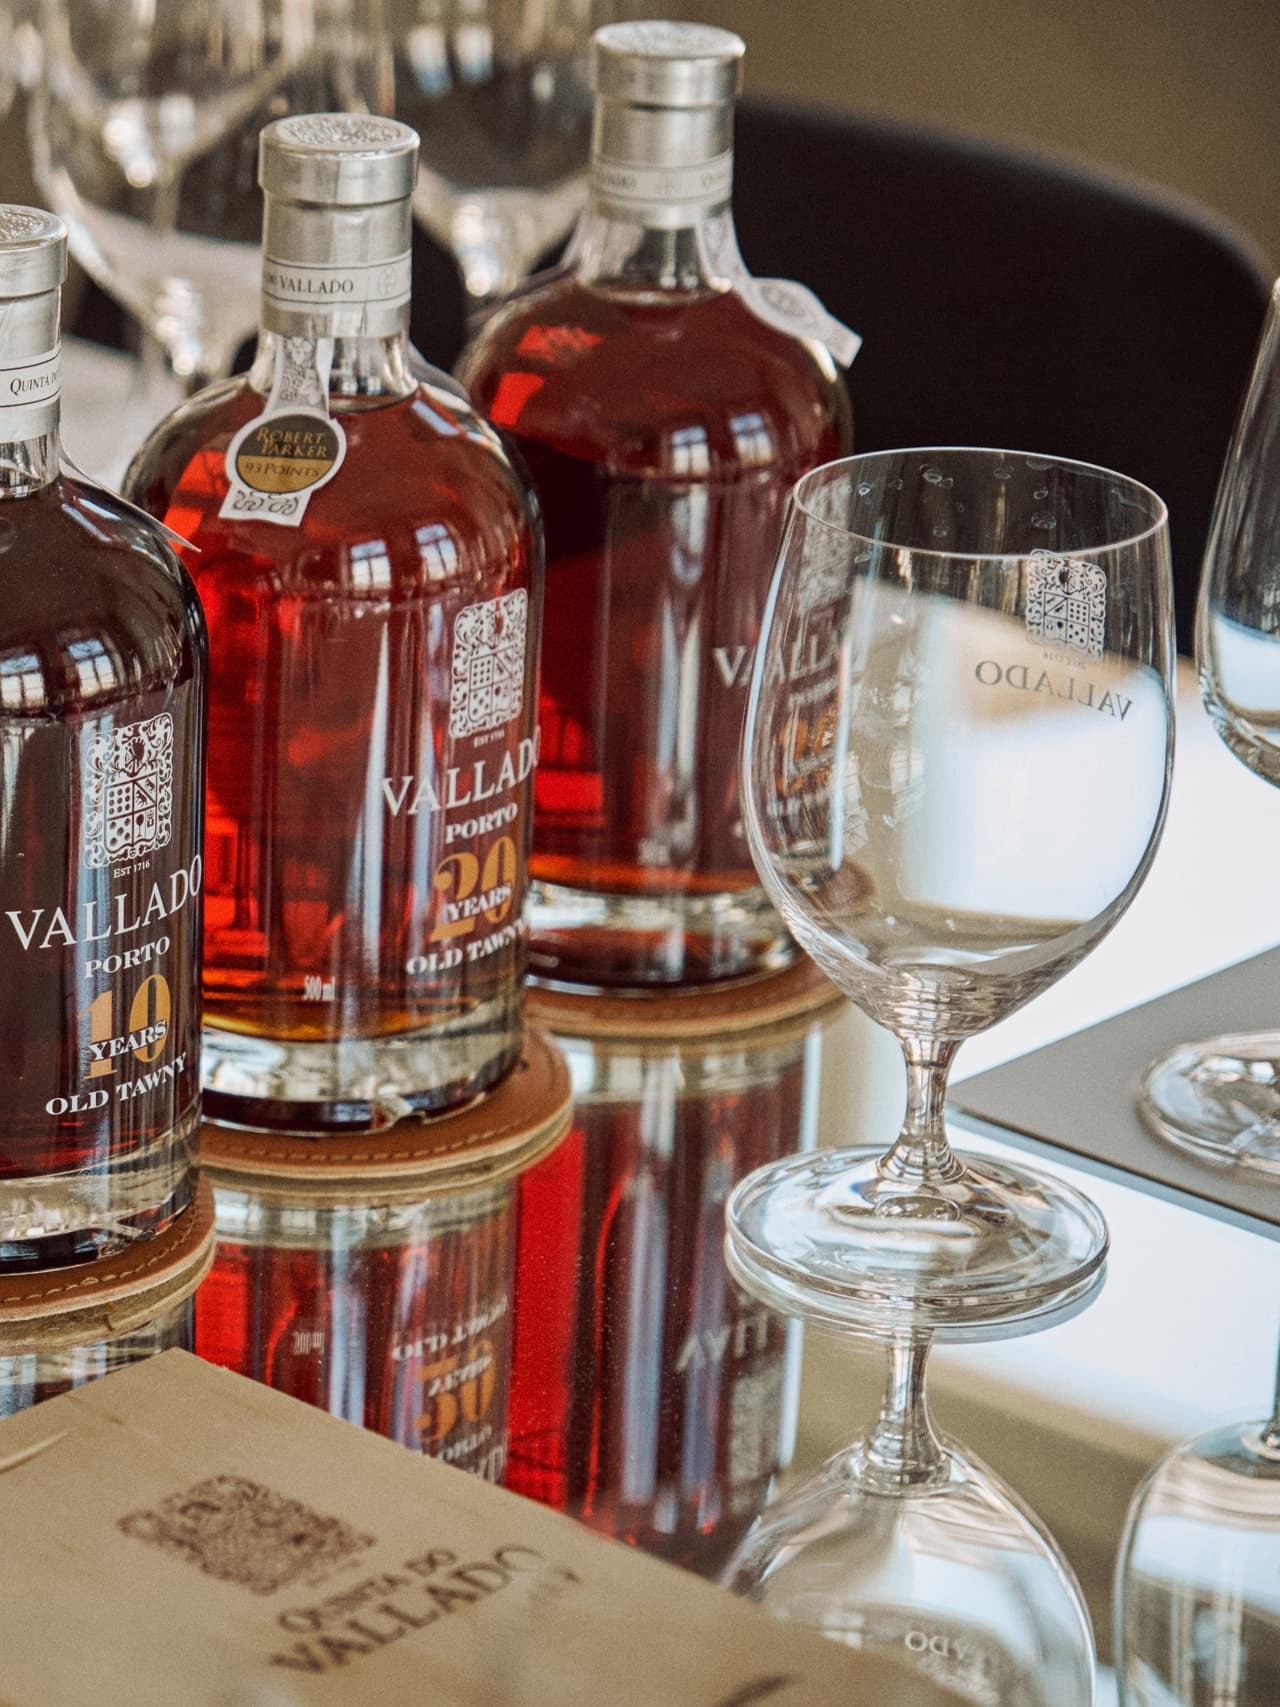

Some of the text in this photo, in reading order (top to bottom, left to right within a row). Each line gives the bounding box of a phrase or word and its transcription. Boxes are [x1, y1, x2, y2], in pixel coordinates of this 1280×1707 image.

[279, 275, 354, 294] VALLADO
[257, 426, 325, 444] ROBERT
[261, 440, 327, 457] PARKER
[382, 725, 542, 818] VALLADO
[445, 802, 519, 845] PORTO
[113, 865, 133, 879] EST
[430, 835, 519, 944] 20
[5, 854, 202, 951] VALLADO
[446, 882, 512, 922] YEARS
[84, 935, 171, 979] PORTO
[406, 948, 464, 975] OLD
[77, 973, 171, 1080] 10
[88, 1019, 169, 1062] YEARS
[45, 1052, 188, 1117] OLD TAWNY
